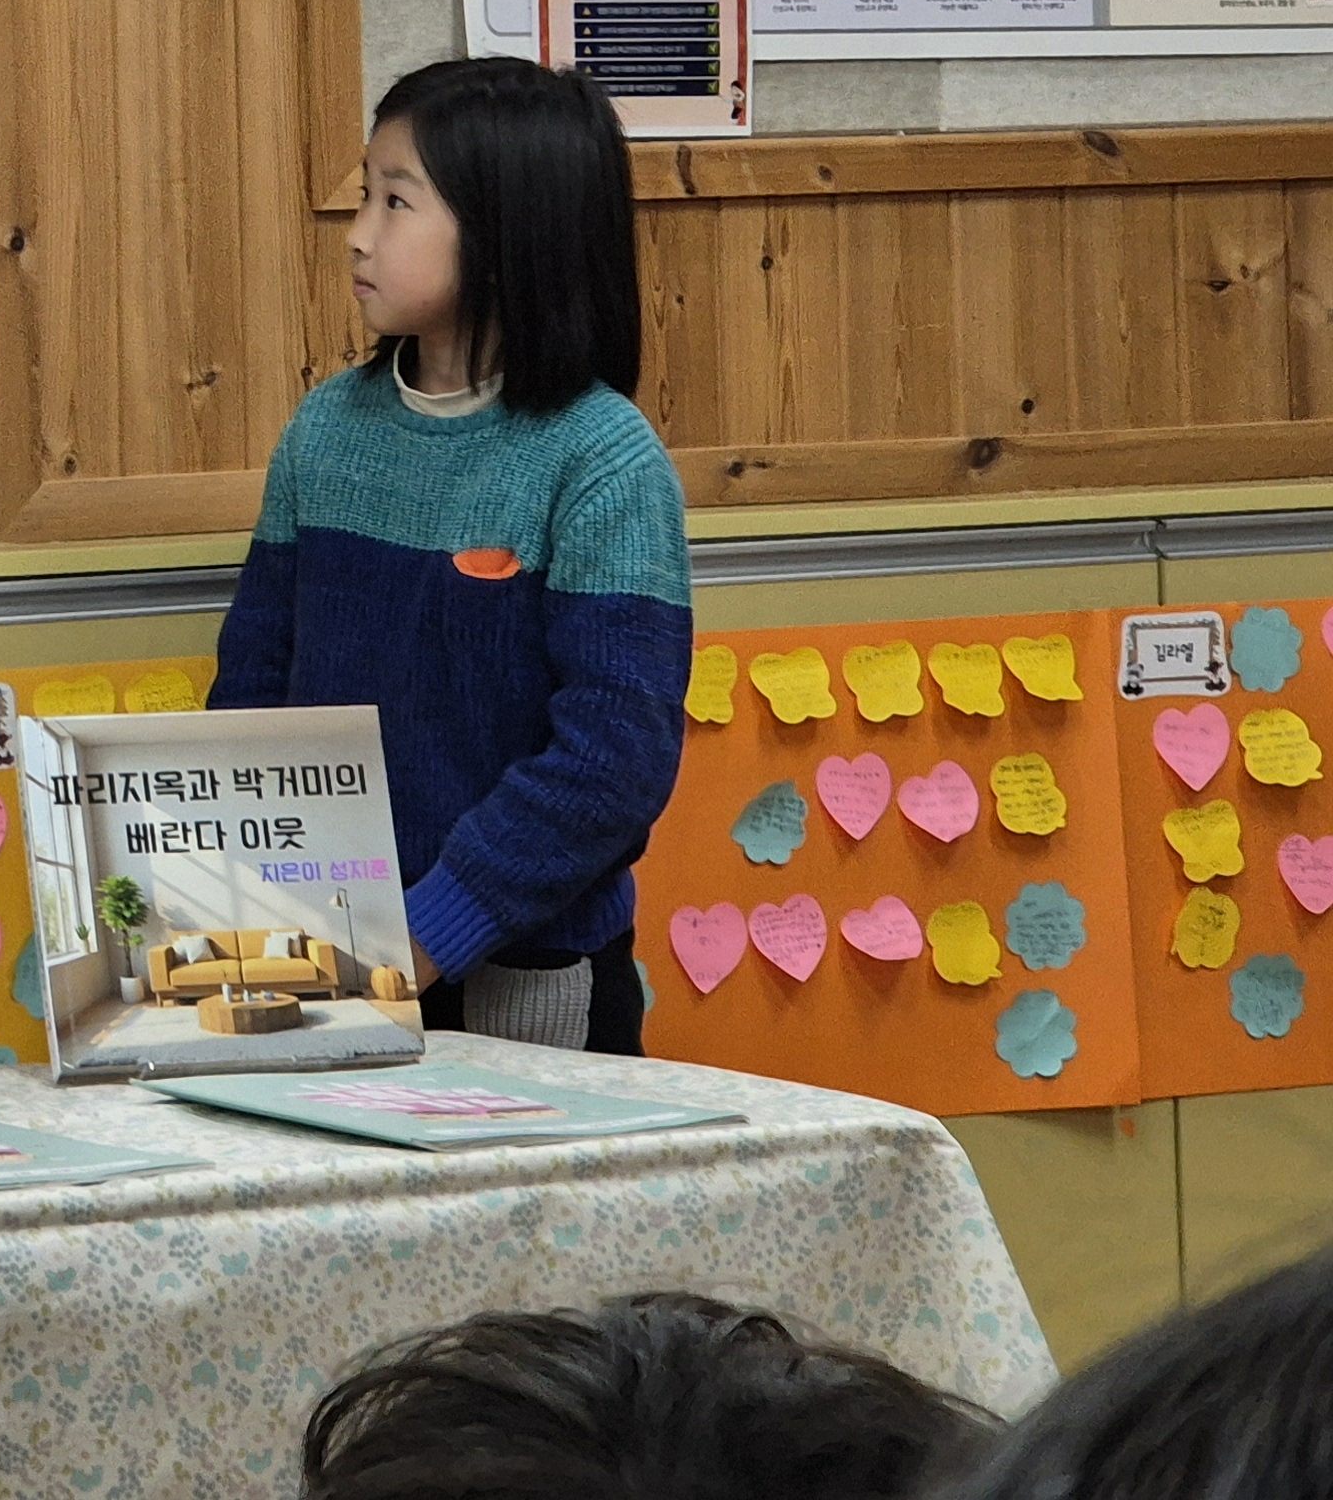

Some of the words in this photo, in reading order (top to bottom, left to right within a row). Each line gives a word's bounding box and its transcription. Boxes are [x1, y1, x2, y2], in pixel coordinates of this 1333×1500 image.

[49, 768, 221, 808] 파리지옥과
[231, 762, 369, 799] 박거미의
[124, 818, 228, 855] 베란다
[239, 816, 307, 853] 이웃
[260, 860, 322, 883] 지은이
